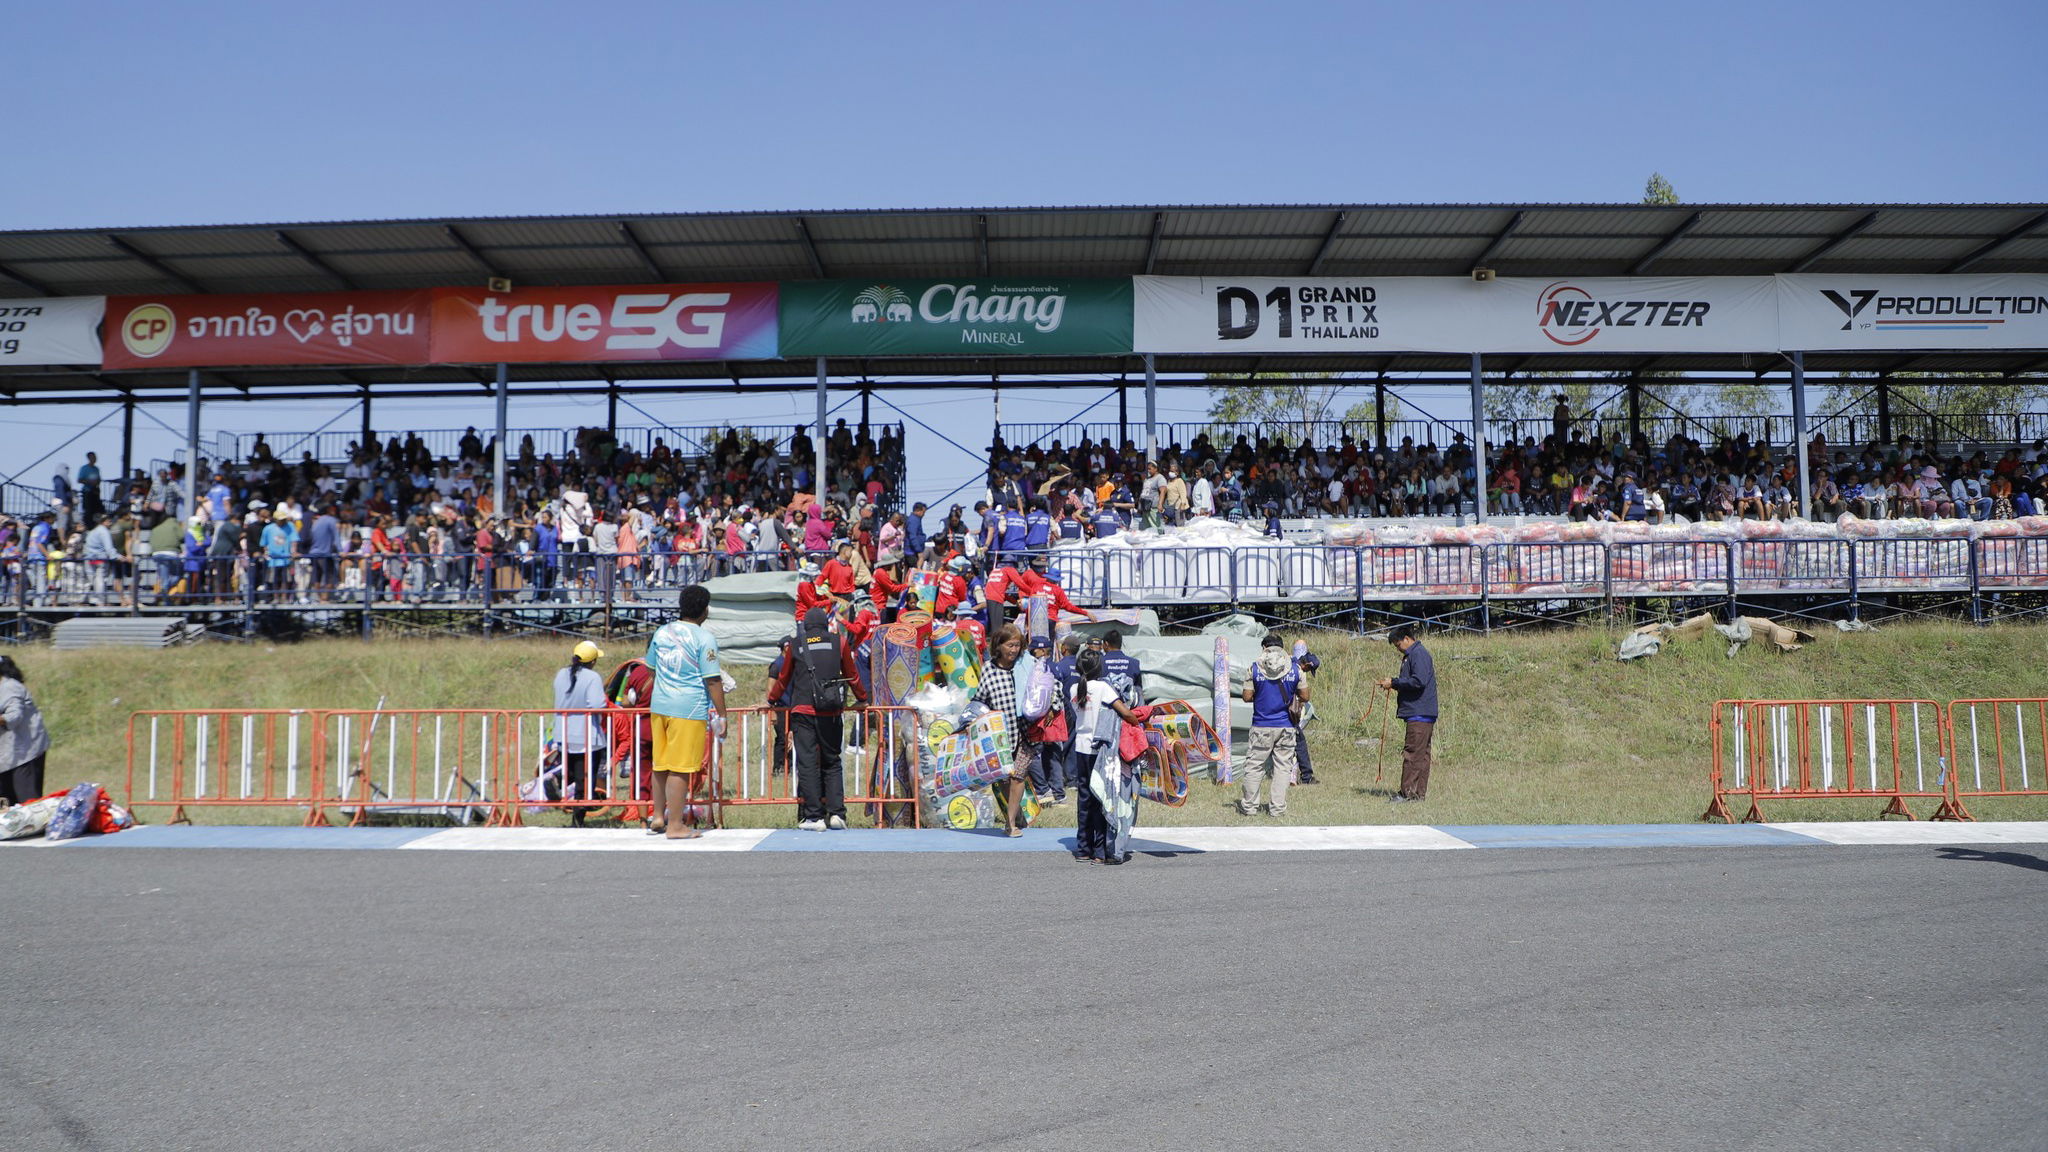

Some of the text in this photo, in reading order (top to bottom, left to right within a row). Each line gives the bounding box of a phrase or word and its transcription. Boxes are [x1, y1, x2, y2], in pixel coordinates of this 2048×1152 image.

[918, 283, 1067, 333] Chang
[1298, 286, 1376, 303] GRAND
[188, 304, 415, 347] จากใจ สู่จาน
[478, 293, 732, 350] true 5G
[1216, 286, 1293, 340] D1
[1301, 305, 1378, 323] PRIX
[1538, 300, 1711, 327] NEXZTER
[129, 318, 168, 340] CP
[1301, 326, 1379, 339] THAILAND
